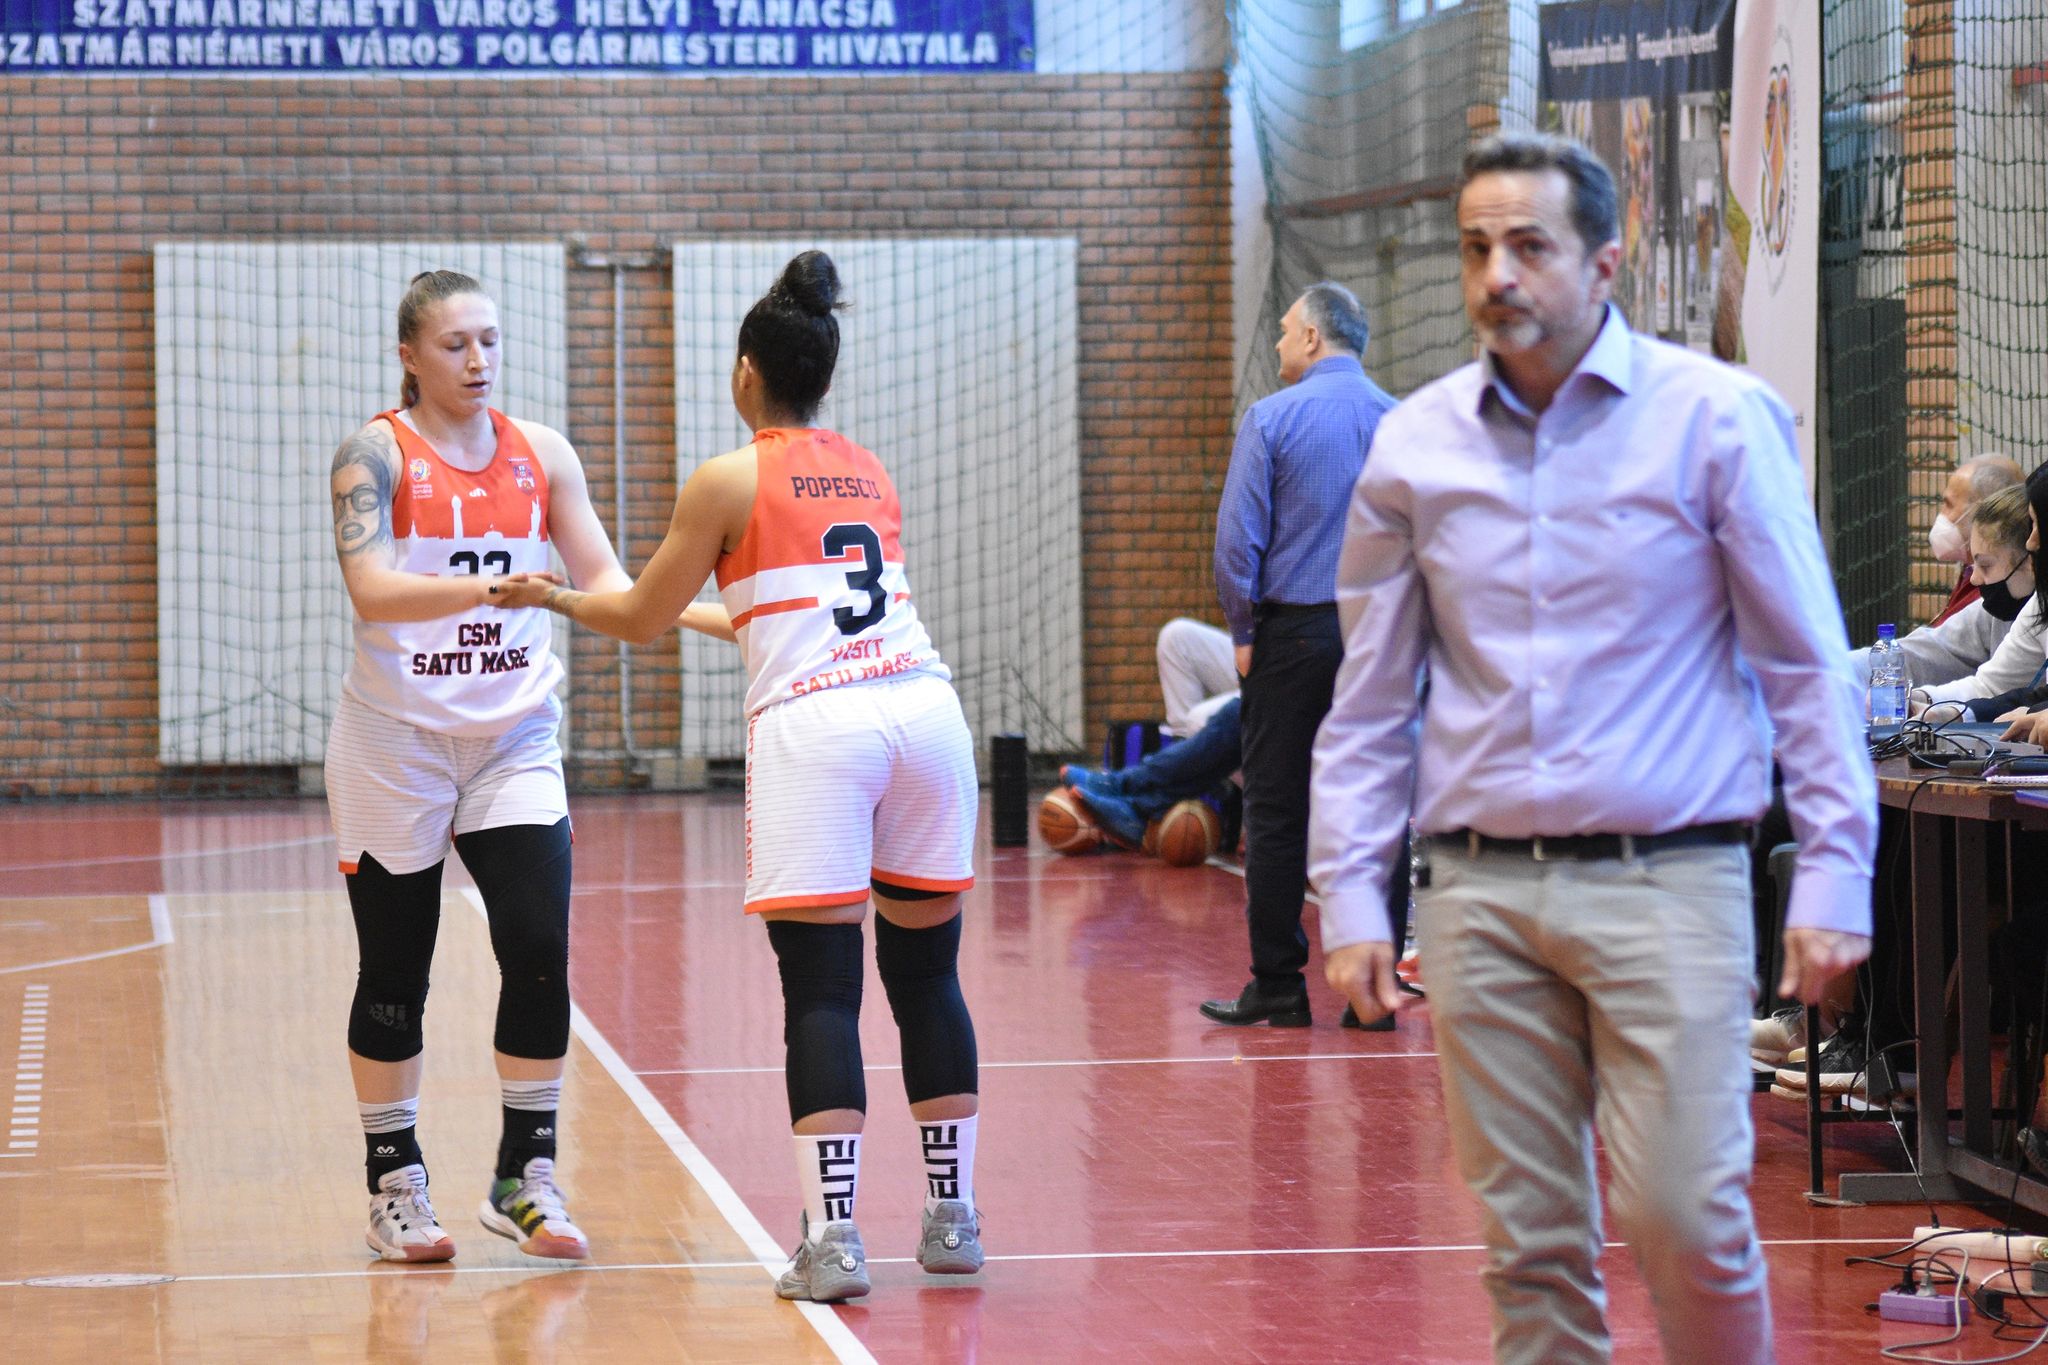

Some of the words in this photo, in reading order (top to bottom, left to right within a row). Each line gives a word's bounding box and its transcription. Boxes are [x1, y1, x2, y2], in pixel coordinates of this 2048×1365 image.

[338, 28, 462, 66] VÁROS
[476, 29, 795, 66] POLGÁRMESTERI
[812, 33, 997, 65] HIVATALA
[790, 476, 882, 500] POPESCU
[822, 523, 887, 636] 3
[458, 622, 502, 647] CSM
[412, 652, 473, 676] SATU
[480, 646, 529, 675] MARE
[829, 637, 885, 662] VISIT
